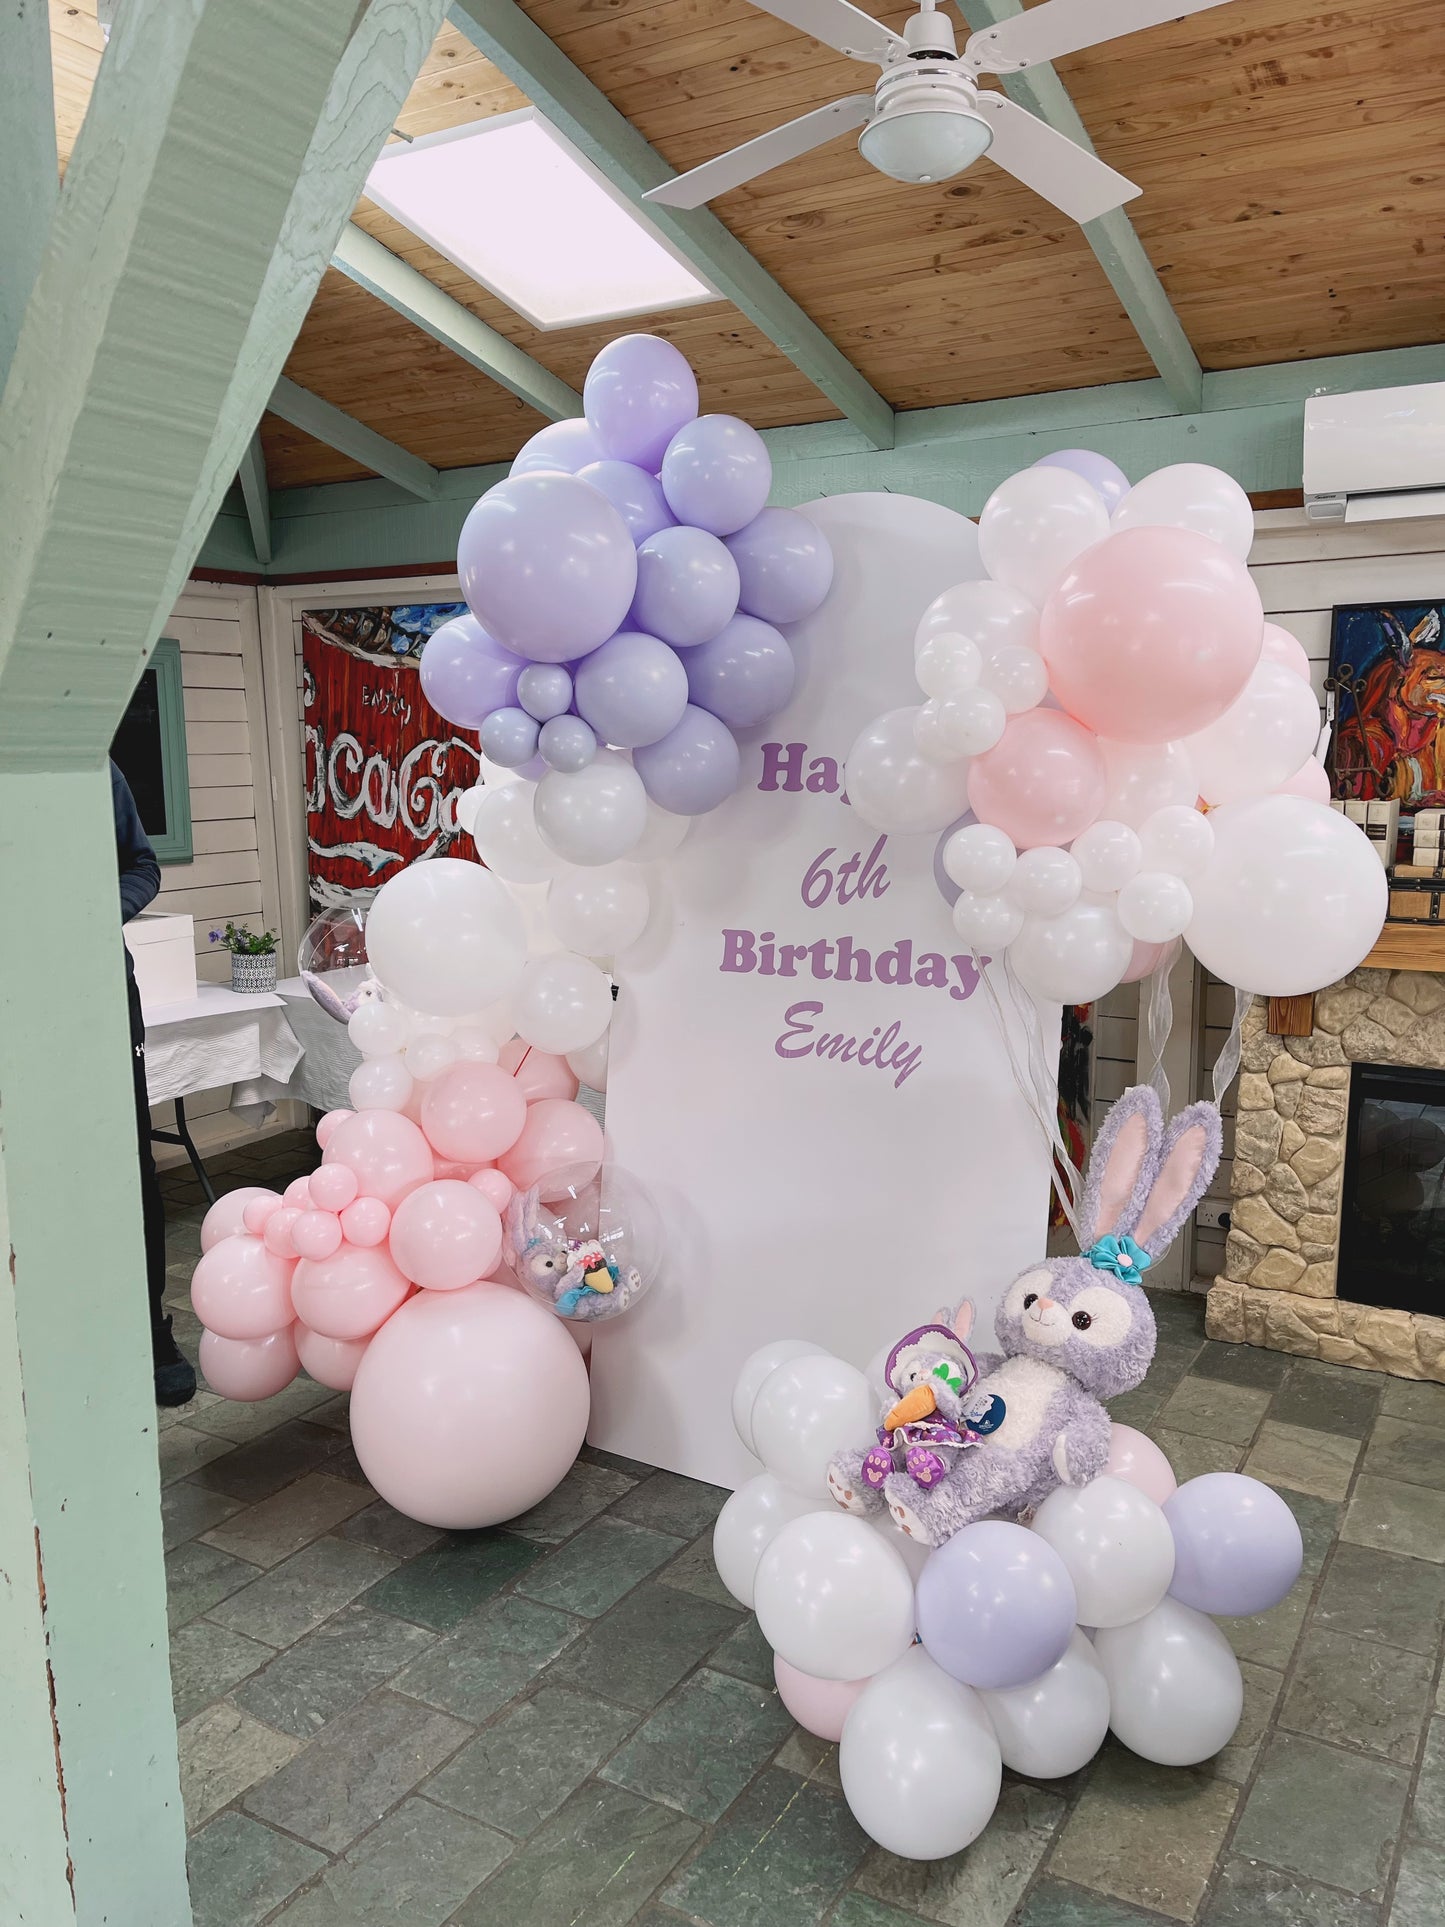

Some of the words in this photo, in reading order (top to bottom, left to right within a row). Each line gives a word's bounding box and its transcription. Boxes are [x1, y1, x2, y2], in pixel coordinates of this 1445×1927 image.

[757, 742, 852, 806] Ha
[801, 833, 891, 909] 6th
[719, 928, 993, 1001] Birthday
[774, 1000, 923, 1089] Emily
